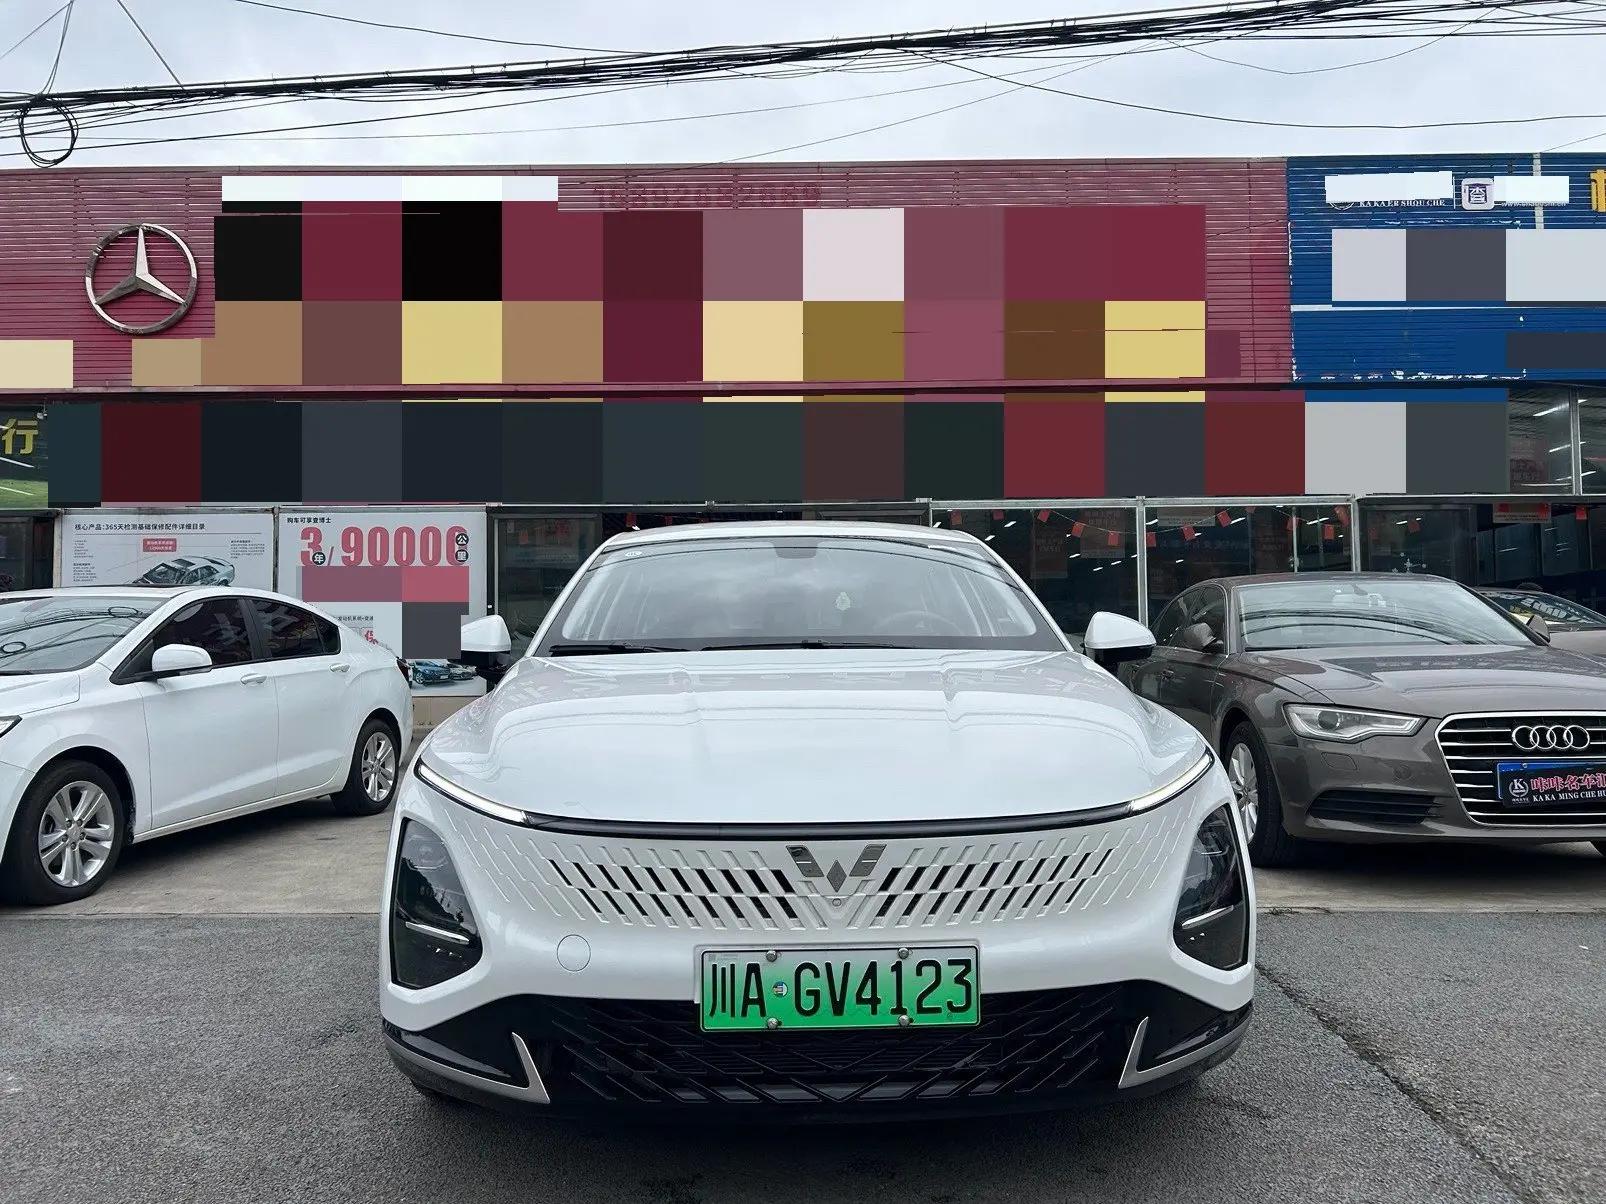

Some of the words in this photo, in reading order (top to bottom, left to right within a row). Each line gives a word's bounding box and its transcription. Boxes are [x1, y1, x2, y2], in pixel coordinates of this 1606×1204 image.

[2, 418, 39, 455] 行
[1559, 791, 1579, 800] MING
[1580, 790, 1597, 799] CHE
